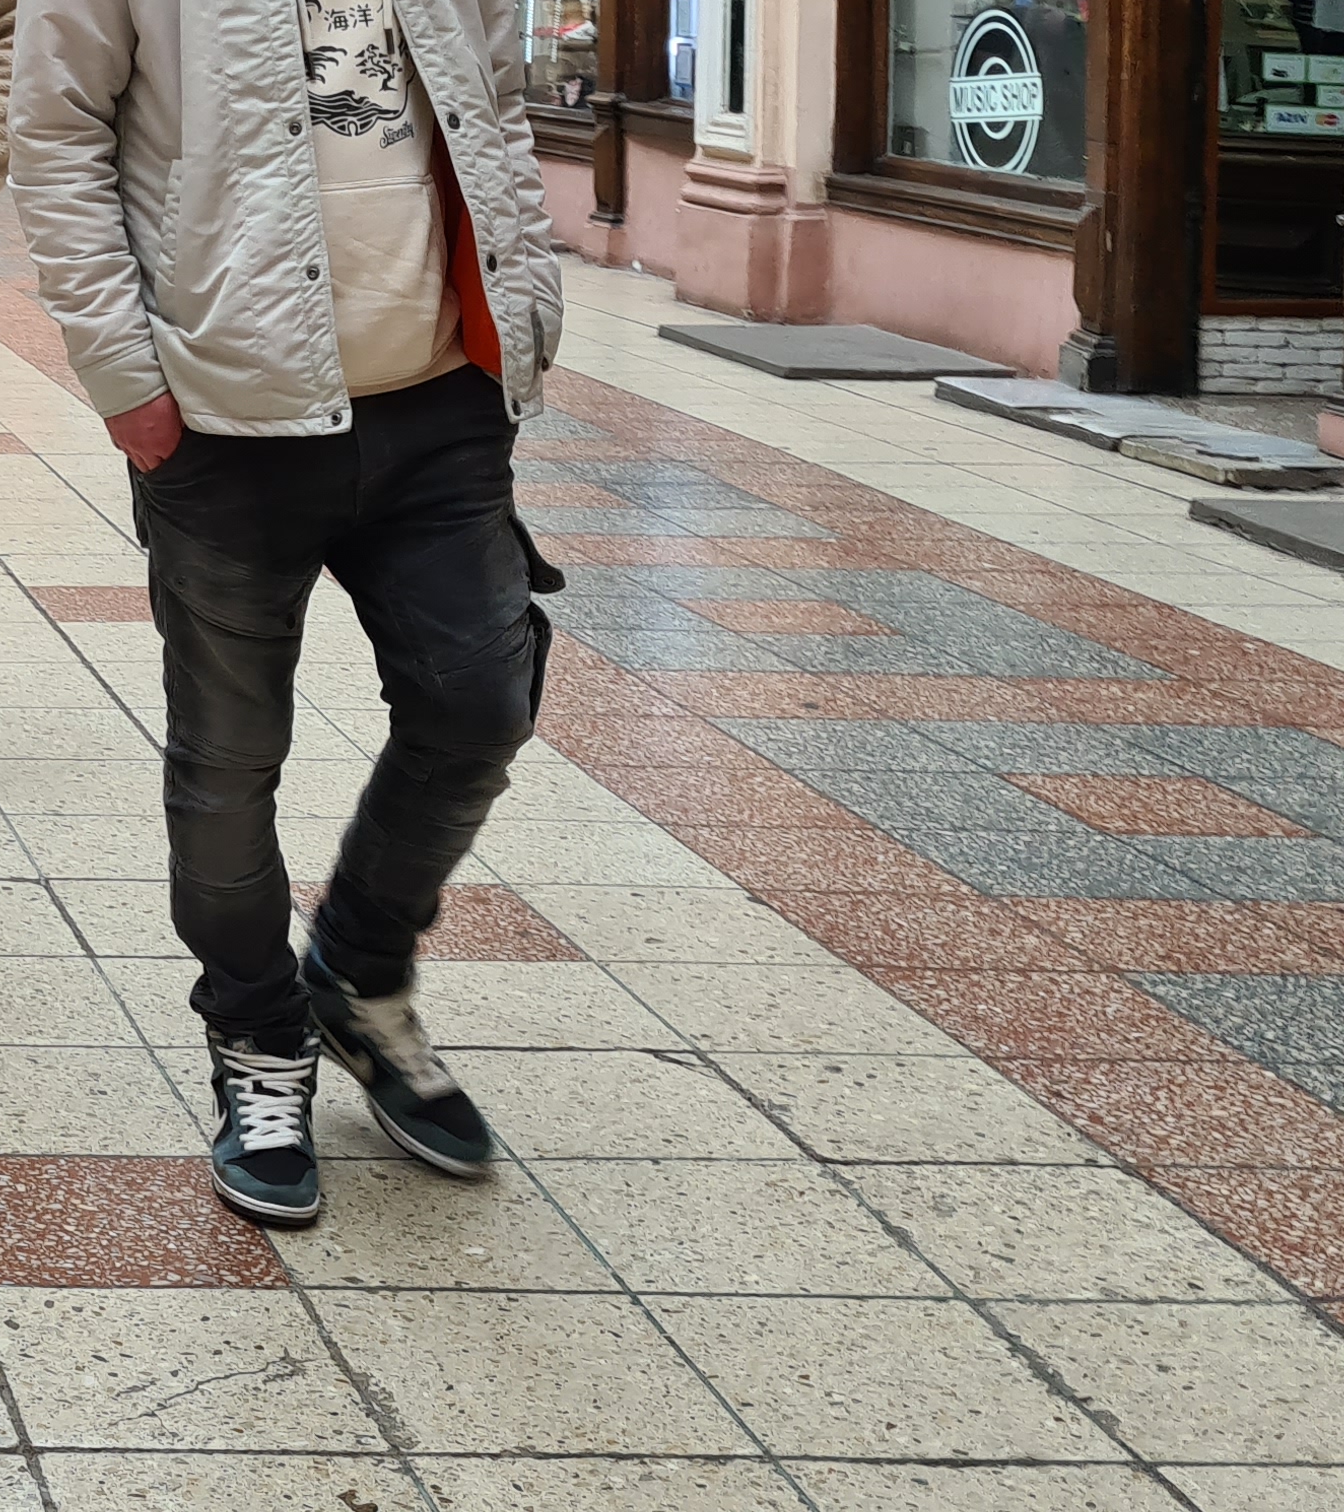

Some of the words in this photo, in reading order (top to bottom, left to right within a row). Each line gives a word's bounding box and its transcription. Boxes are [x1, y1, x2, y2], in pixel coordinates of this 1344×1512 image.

[324, 3, 374, 32] 海洋
[952, 84, 998, 114] MUSIC
[1001, 81, 1039, 112] SHOP
